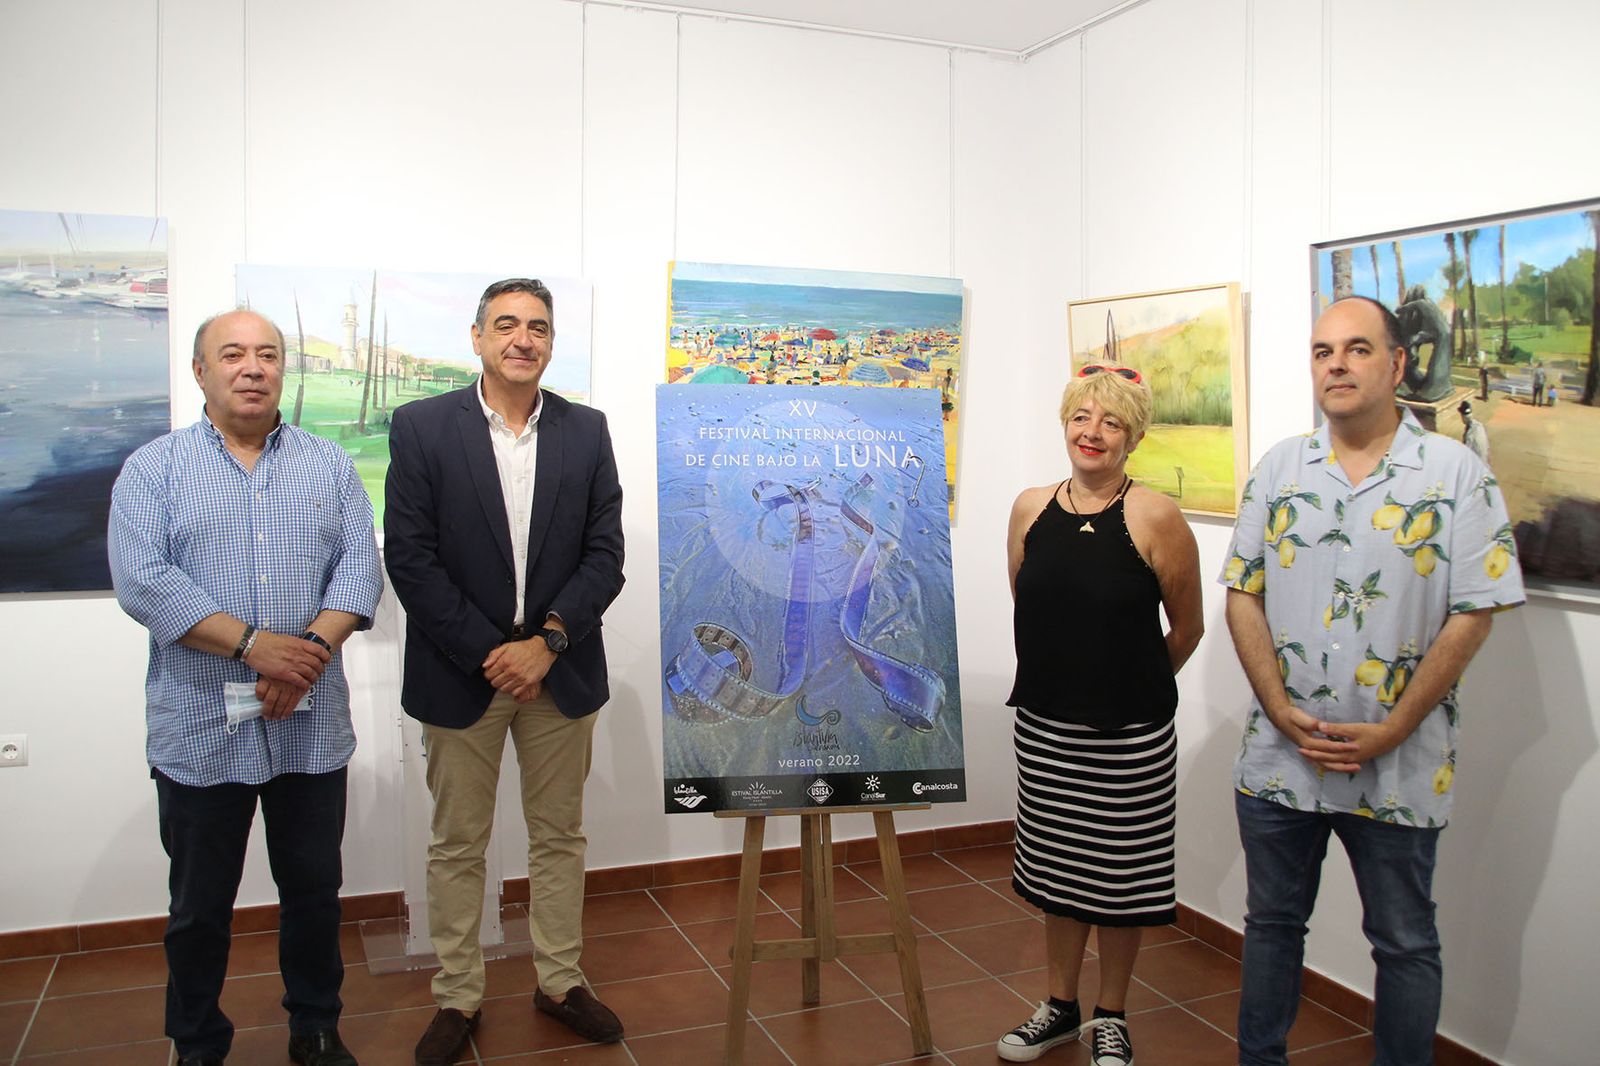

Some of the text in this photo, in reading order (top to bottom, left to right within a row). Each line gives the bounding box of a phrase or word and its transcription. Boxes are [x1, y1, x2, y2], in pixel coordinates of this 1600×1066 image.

[788, 399, 817, 418] XV
[699, 427, 906, 443] FESTIVAL INTERNACIONAL
[686, 444, 921, 469] DE CINE BAJO LA LUNA
[778, 754, 860, 768] verano 2022
[811, 786, 830, 796] USISA
[912, 781, 958, 795] Canalcosta
